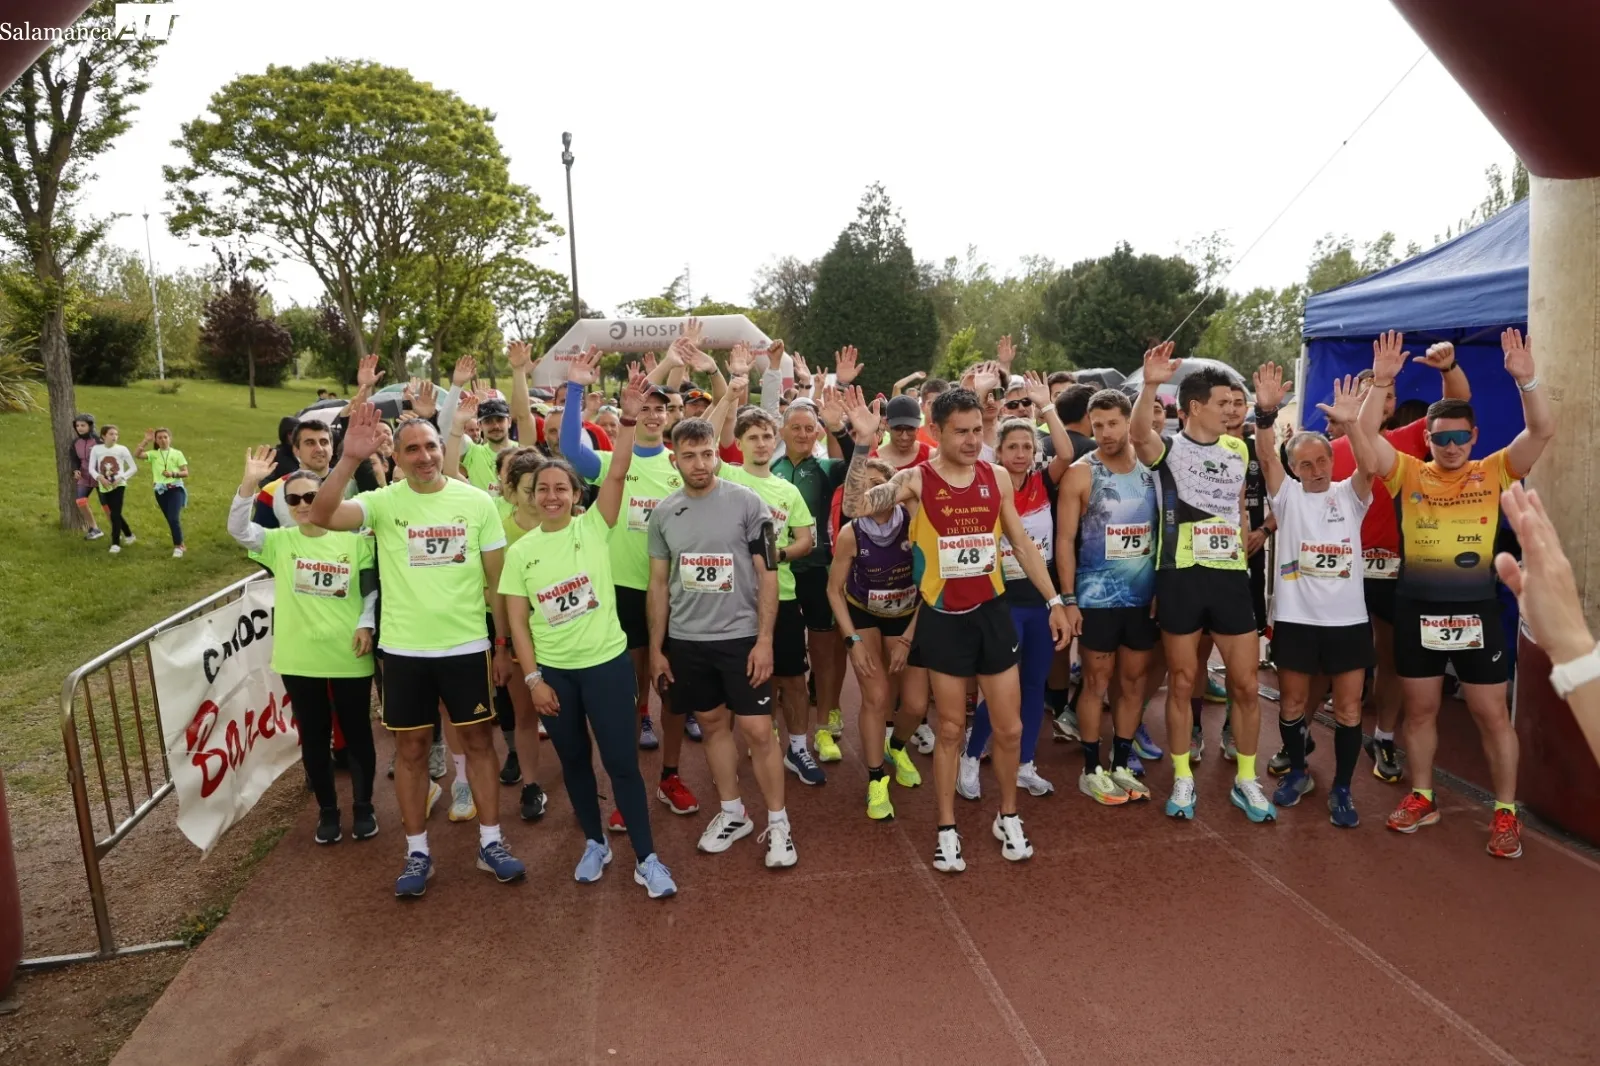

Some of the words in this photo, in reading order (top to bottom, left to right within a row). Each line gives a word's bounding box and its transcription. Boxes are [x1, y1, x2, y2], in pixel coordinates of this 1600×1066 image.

[955, 517, 979, 526] VINO
[408, 526, 466, 539] bedunia
[947, 527, 960, 535] DE
[962, 525, 987, 534] TORO
[426, 538, 449, 554] 57
[939, 536, 995, 550] bedunia
[1121, 535, 1141, 549] 75
[1209, 535, 1229, 550] 85
[1301, 542, 1352, 554] bedunia
[681, 556, 733, 567] bedunia
[957, 547, 980, 565] 48
[1315, 554, 1337, 569] 25
[296, 559, 349, 575] bedunia
[1365, 558, 1386, 570] 70
[312, 571, 334, 588] 18
[695, 566, 717, 582] 28
[536, 575, 590, 604] bedunia
[555, 591, 580, 613] 26
[883, 599, 901, 609] 21
[1439, 627, 1464, 642] 37
